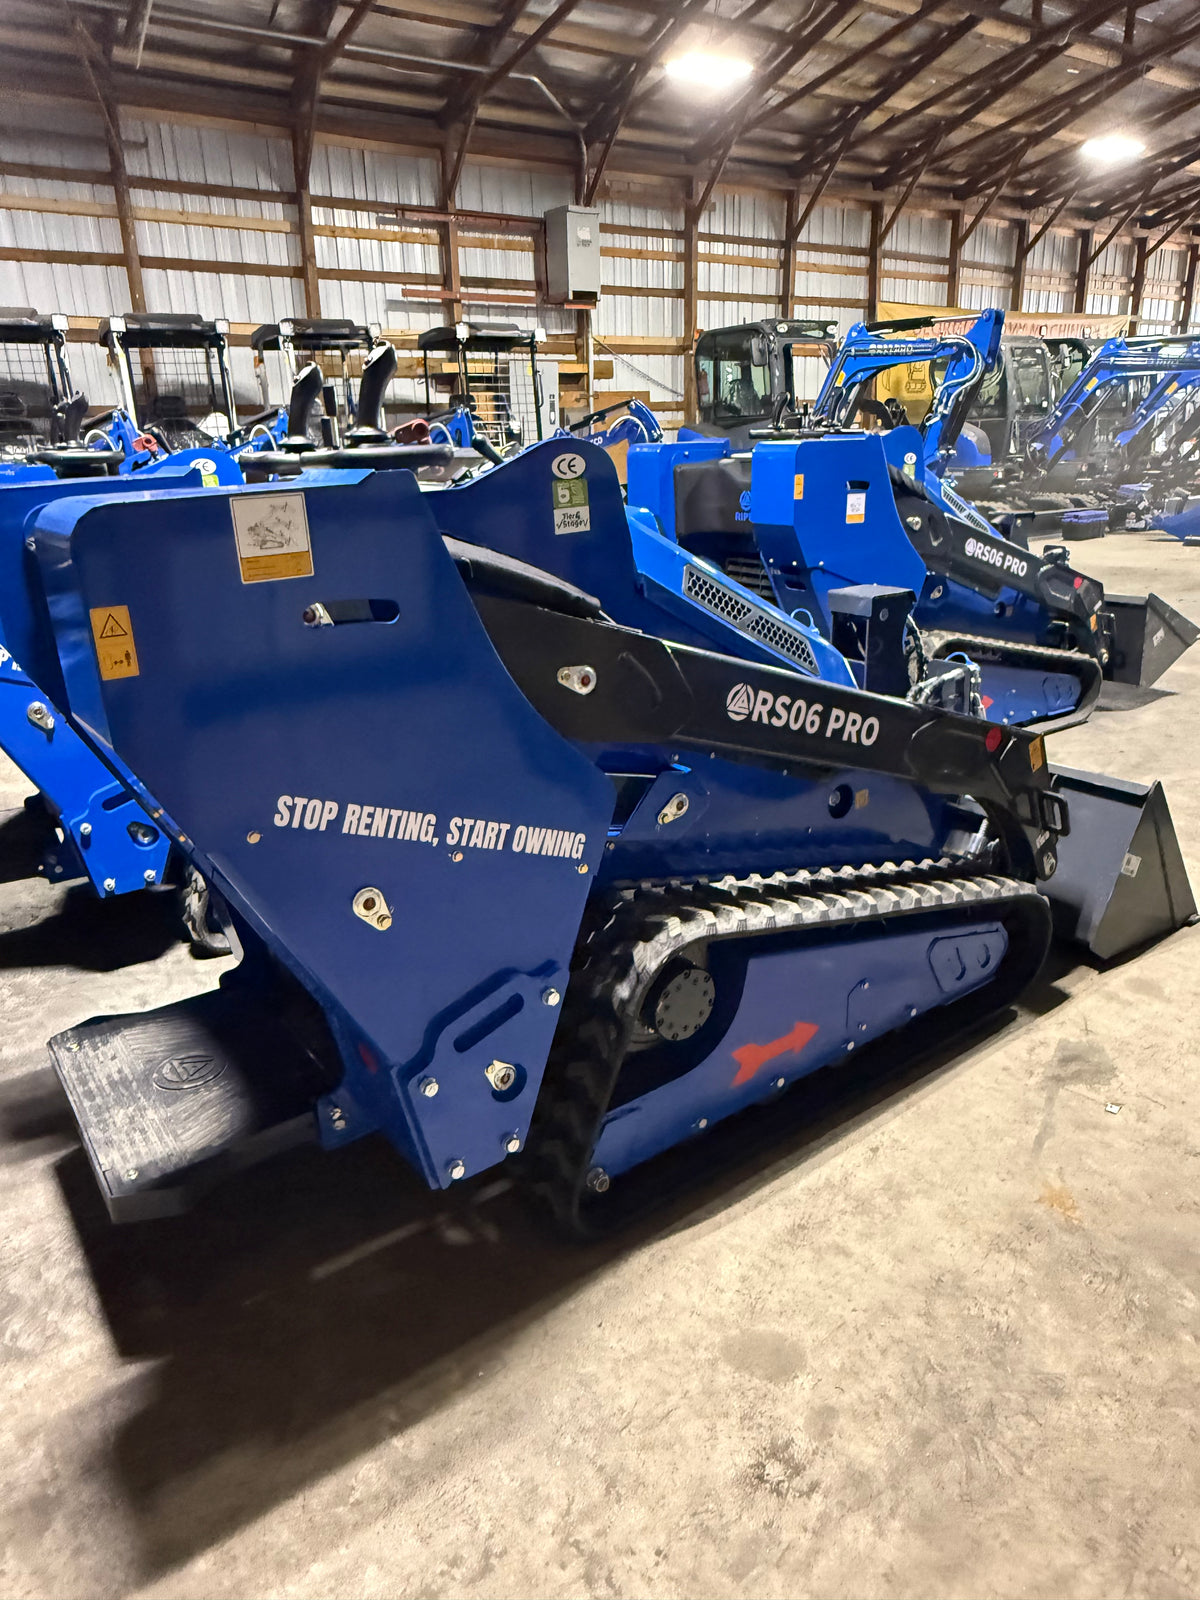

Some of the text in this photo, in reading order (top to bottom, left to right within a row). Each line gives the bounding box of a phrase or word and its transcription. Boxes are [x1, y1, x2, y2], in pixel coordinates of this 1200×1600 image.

[557, 457, 577, 475] CE
[735, 512, 750, 521] RIP
[974, 541, 1028, 577] RS06 PRO
[751, 690, 880, 746] RS06 PRO
[274, 795, 586, 859] STOP RENTING, START OWNING
